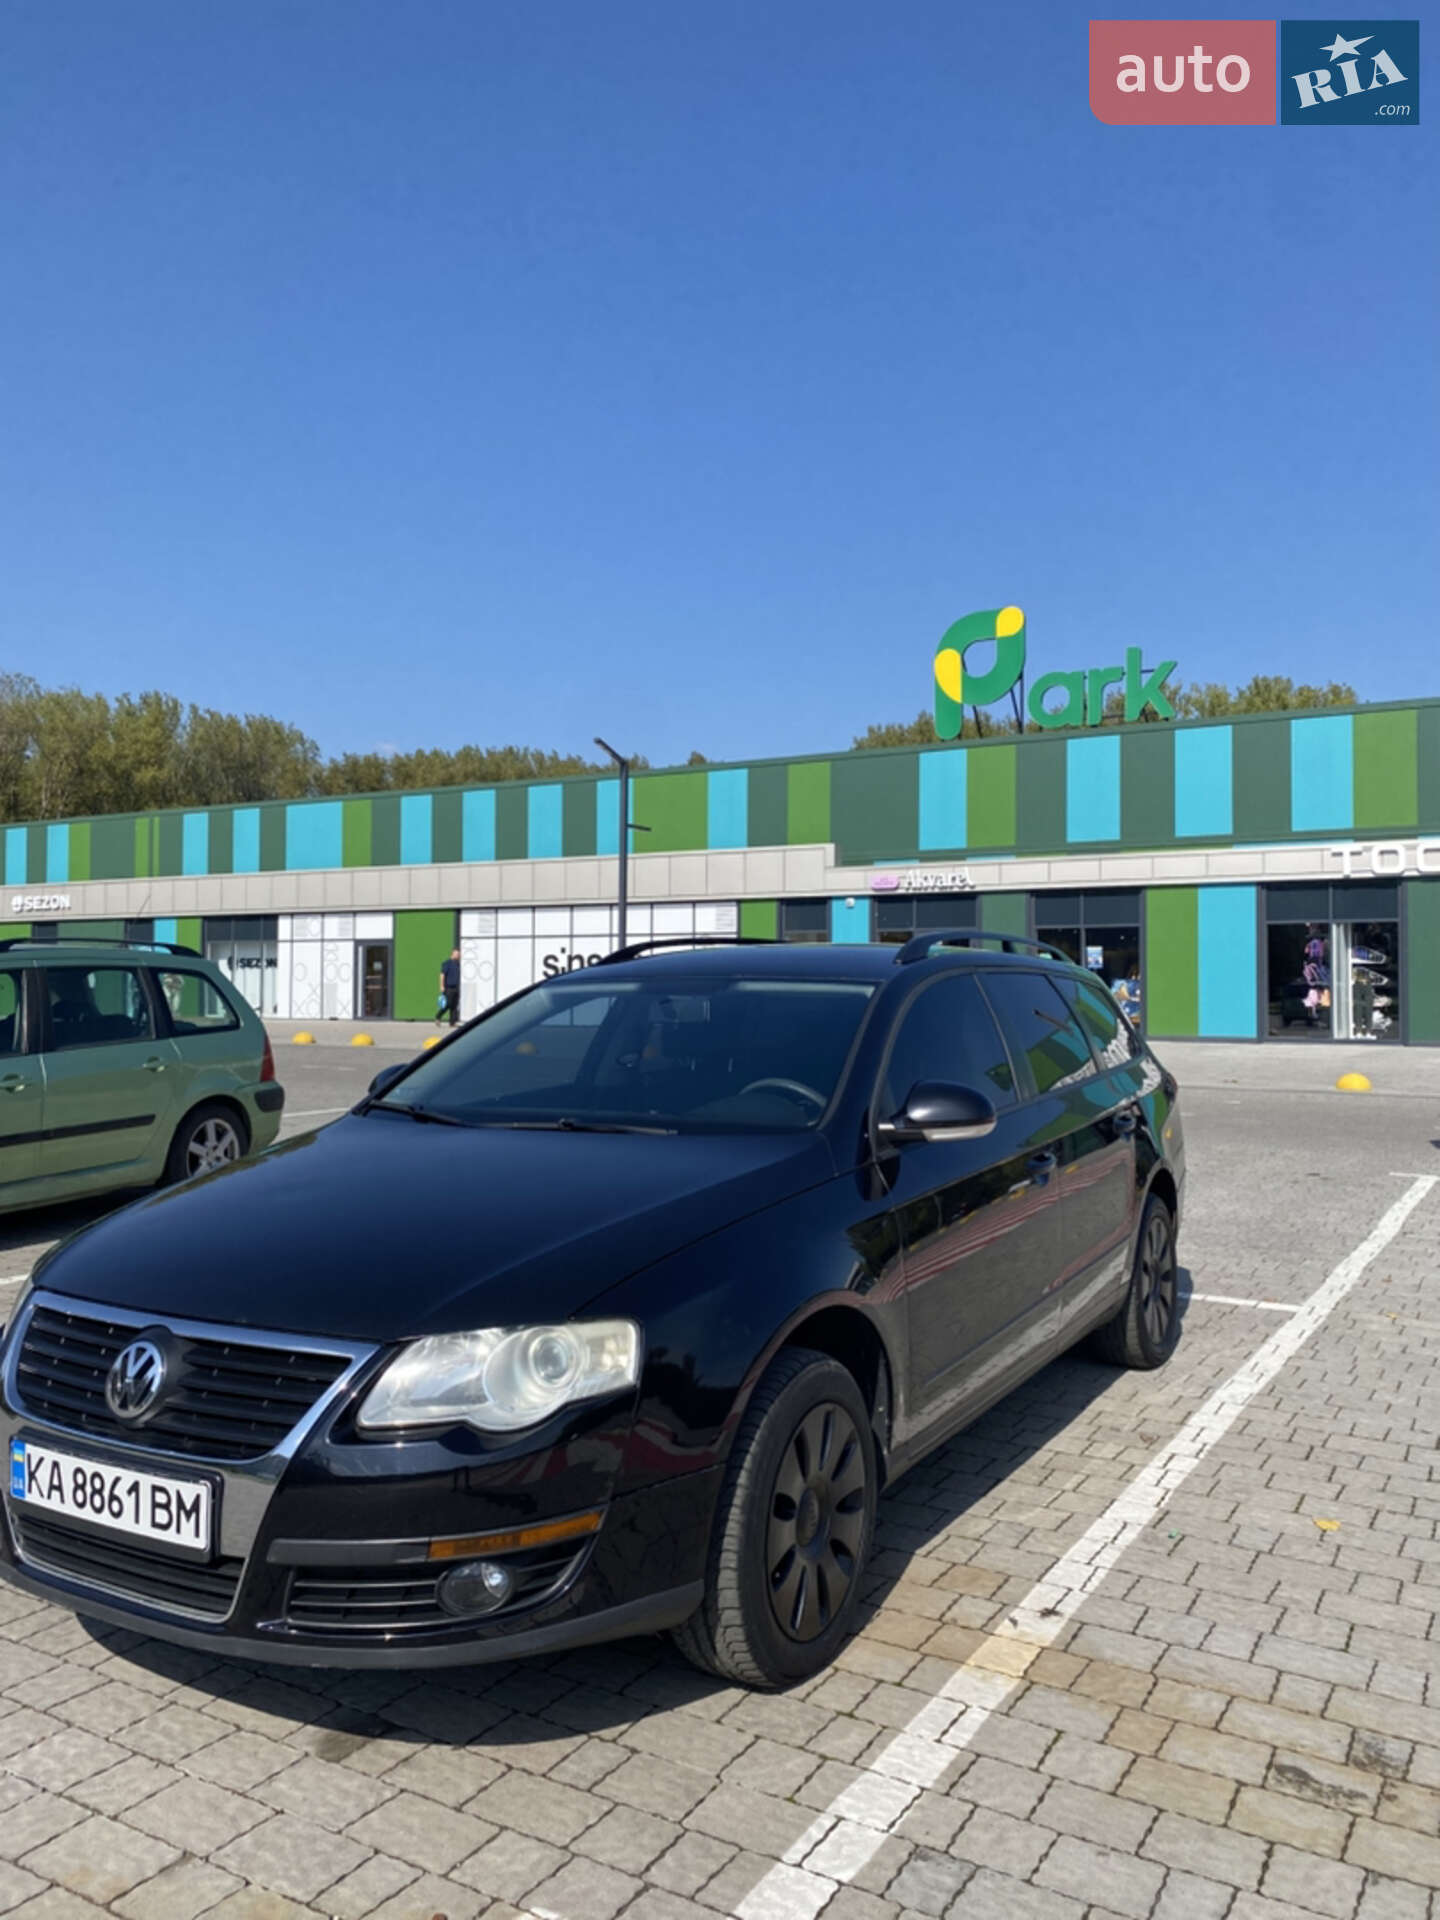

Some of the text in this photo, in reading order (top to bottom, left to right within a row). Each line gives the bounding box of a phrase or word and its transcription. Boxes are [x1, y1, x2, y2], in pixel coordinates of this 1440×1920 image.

[934, 605, 1178, 740] Park
[24, 894, 71, 910] SEZON
[27, 1453, 202, 1539] KA 8861 BM
